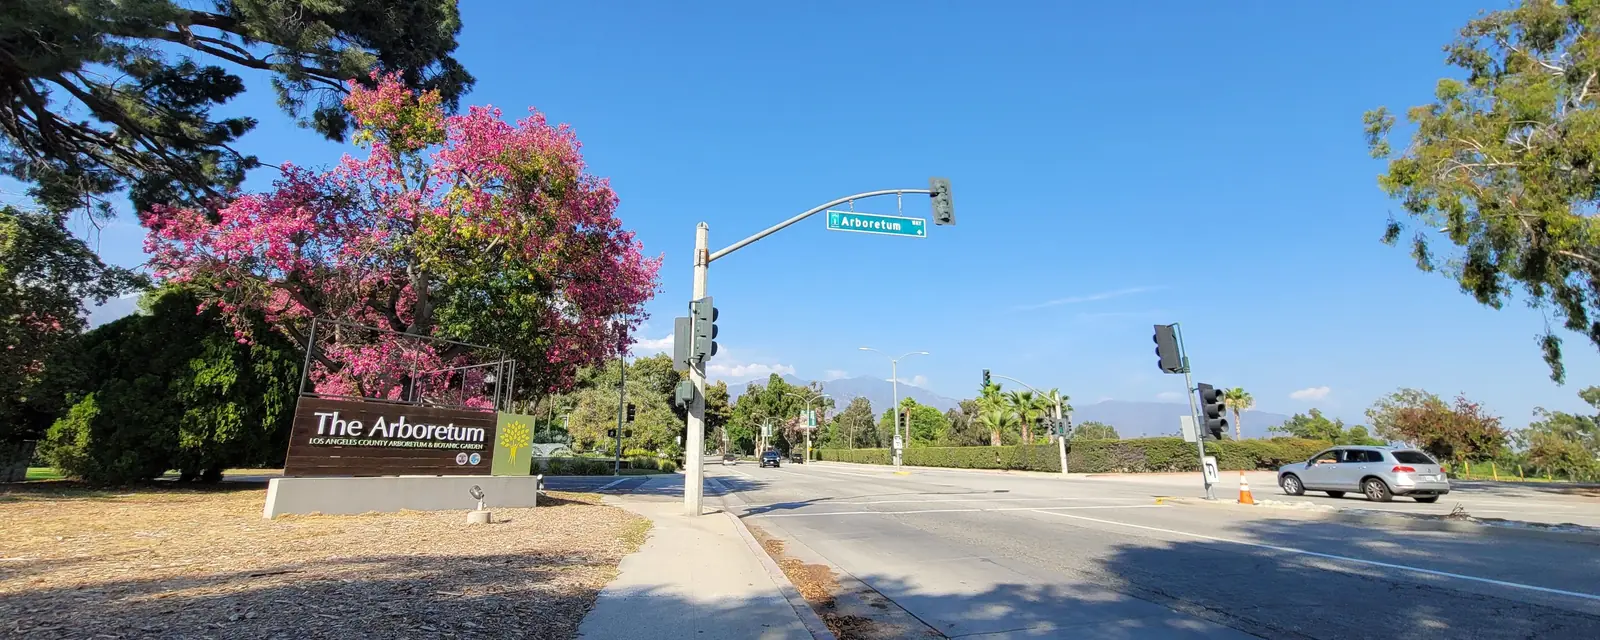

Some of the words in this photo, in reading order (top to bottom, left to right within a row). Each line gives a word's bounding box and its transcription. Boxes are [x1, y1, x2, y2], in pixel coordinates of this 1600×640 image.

[841, 216, 900, 230] Arboretum
[314, 412, 362, 436] The
[368, 416, 484, 442] Arboretum
